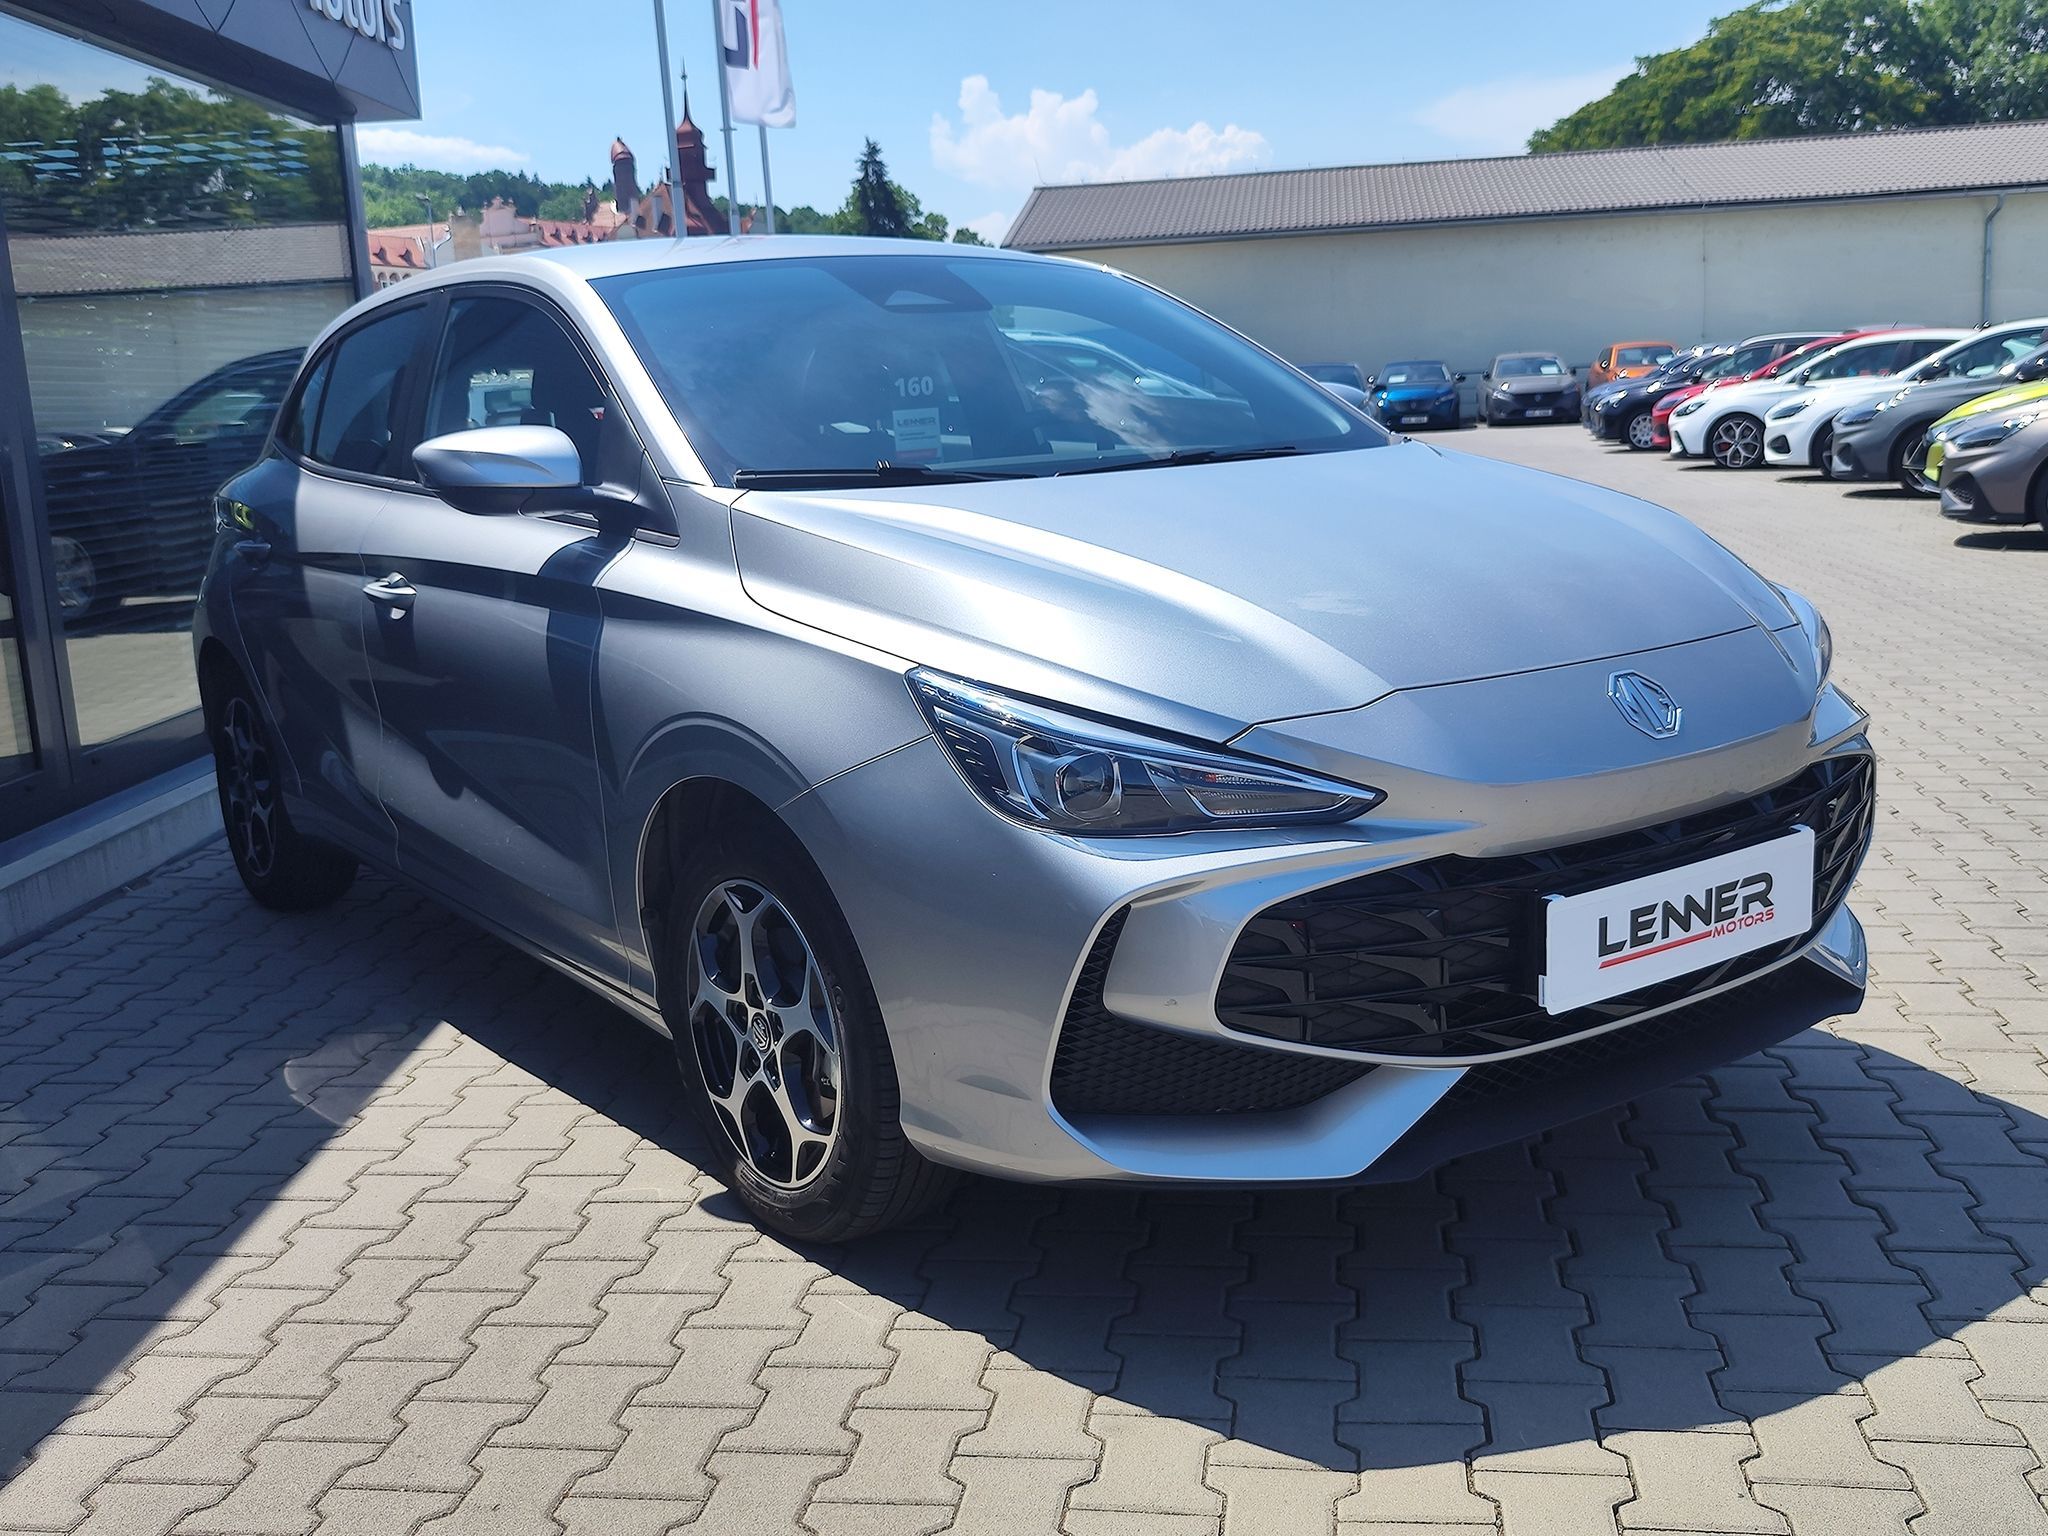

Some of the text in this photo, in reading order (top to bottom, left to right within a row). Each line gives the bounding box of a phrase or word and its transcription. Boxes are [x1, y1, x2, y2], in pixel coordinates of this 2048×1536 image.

[894, 376, 934, 397] 160
[1598, 872, 1775, 958] LENNER
[1712, 908, 1776, 939] MOTORS
